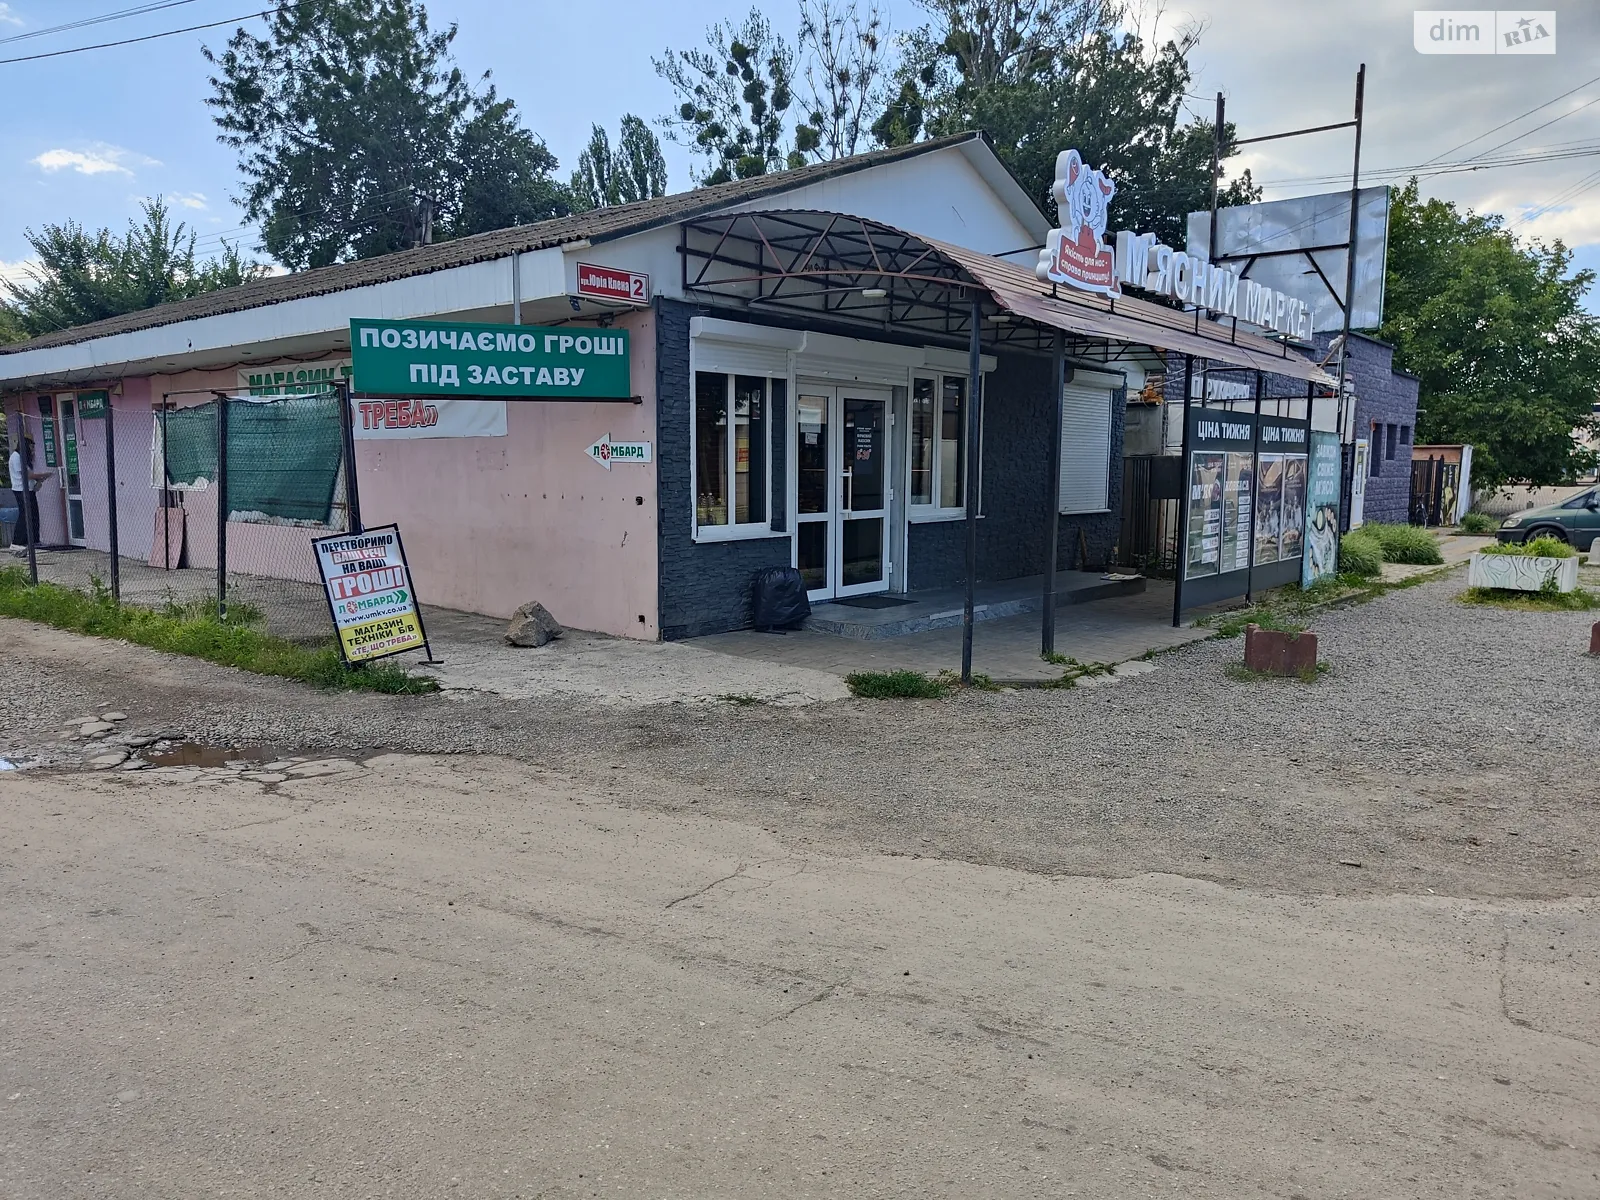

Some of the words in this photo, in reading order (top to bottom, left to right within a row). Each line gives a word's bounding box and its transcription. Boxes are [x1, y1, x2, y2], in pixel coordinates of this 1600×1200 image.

[1064, 244, 1084, 263] Якість
[1084, 256, 1095, 267] для
[1060, 259, 1081, 277] справа
[607, 276, 630, 292] Клена
[633, 278, 644, 297] 2
[359, 327, 536, 353] ПОЗИЧАЄМО
[544, 334, 624, 356] ГРОШІ
[249, 368, 335, 397] МАГАЗИН
[409, 363, 460, 388] ПІД
[467, 365, 585, 387] ЗАСТАВУ
[359, 399, 439, 430] ТРЕБА»
[1197, 420, 1220, 441] ЦІНА
[1221, 422, 1251, 441] ТИЖНЯ
[1262, 426, 1280, 444] ЦІНА
[1281, 427, 1305, 443] ТИЖНЯ
[593, 443, 644, 460] ЛОМБАРД
[320, 534, 394, 553] ПЕРЕТВОРИМО
[334, 548, 363, 564] ВАШІ
[363, 545, 386, 559] РЕЧІ
[341, 563, 357, 575] НА
[330, 567, 404, 600] ГРОШІ
[338, 595, 395, 614] ЛОМБАРД
[343, 605, 408, 624] www.umkv.co.ua
[346, 629, 394, 647] ТЕХНІКИ
[398, 624, 415, 635] Б/В
[354, 618, 404, 637] МАГАЗИН
[370, 641, 385, 651] ЩО
